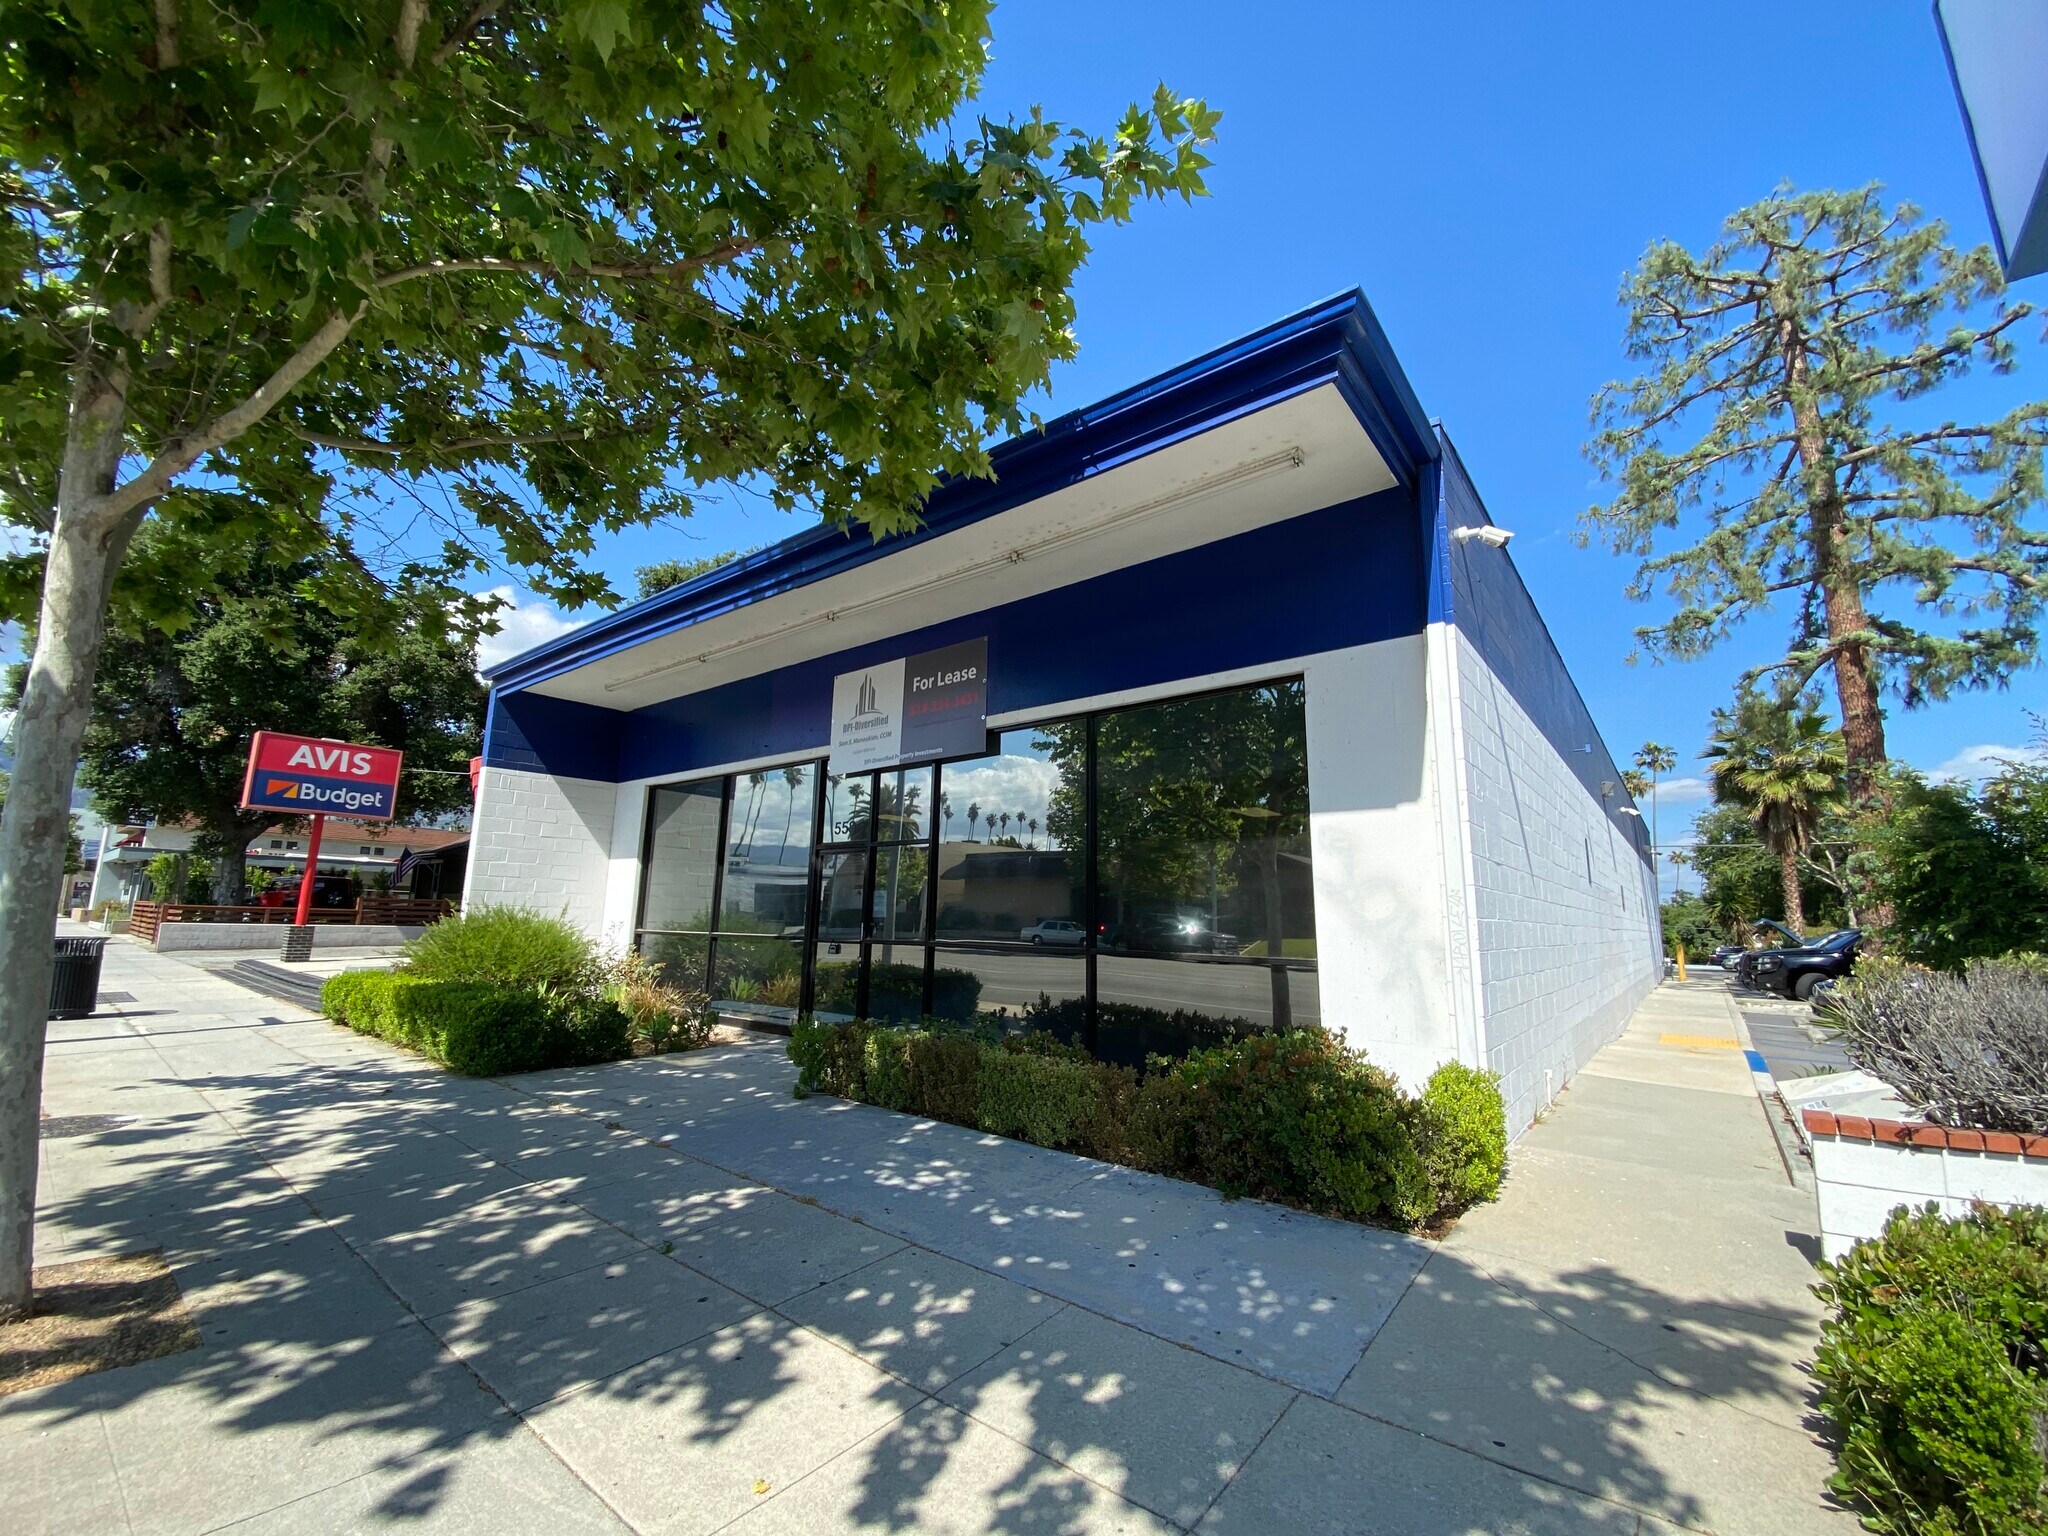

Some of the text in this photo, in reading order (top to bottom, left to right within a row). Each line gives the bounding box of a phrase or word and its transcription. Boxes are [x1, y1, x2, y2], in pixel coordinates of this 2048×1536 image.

[912, 667, 977, 693] For Lease
[842, 714, 889, 733] DPI-Diversified
[287, 744, 373, 776] AVIS
[299, 783, 383, 810] Budget
